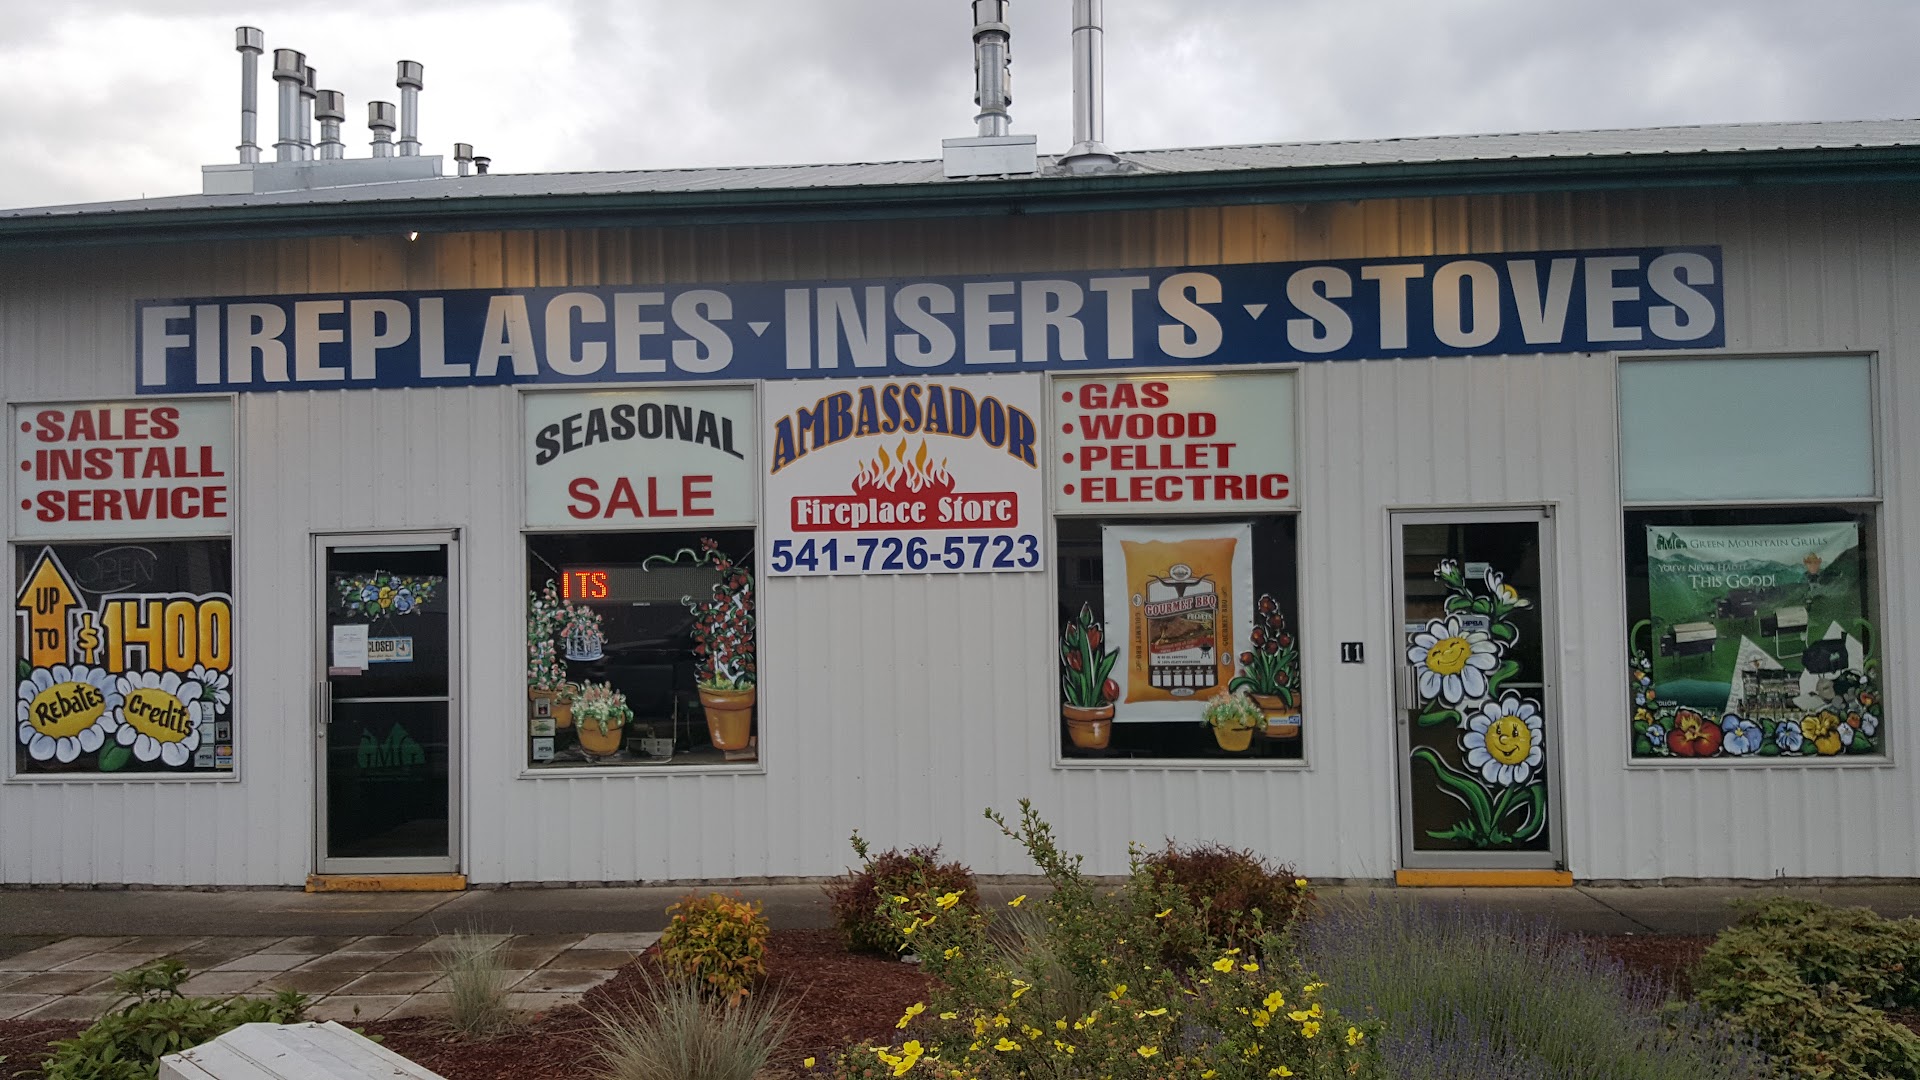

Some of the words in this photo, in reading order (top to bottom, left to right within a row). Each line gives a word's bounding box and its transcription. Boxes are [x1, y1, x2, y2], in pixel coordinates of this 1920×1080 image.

[142, 288, 733, 386] FIREPLACES
[784, 272, 1223, 370] INSERTS
[1286, 252, 1716, 353] STOVES
[1079, 382, 1169, 410] GAS
[36, 407, 180, 443] SALES
[535, 403, 744, 466] SEASONAL
[769, 382, 1038, 475] AMBASSADOR
[1079, 412, 1217, 440] WOOD
[36, 446, 225, 481] INSTALL
[1080, 443, 1237, 472] PELLET
[567, 474, 714, 520] SALE
[1080, 473, 1289, 503] ELECTRIC
[36, 486, 228, 523] SERVICE
[797, 498, 927, 529] Fireplace
[938, 495, 1012, 522] Store
[771, 534, 1040, 572] 541-726-5723
[77, 556, 154, 583] OPEN
[562, 571, 608, 599] ITS
[36, 587, 61, 615] UP
[1145, 597, 1194, 616] GOURMET
[1195, 594, 1217, 608] BBQ
[35, 628, 59, 650] TO
[368, 640, 394, 652] CLOSED
[1343, 643, 1361, 661] 11
